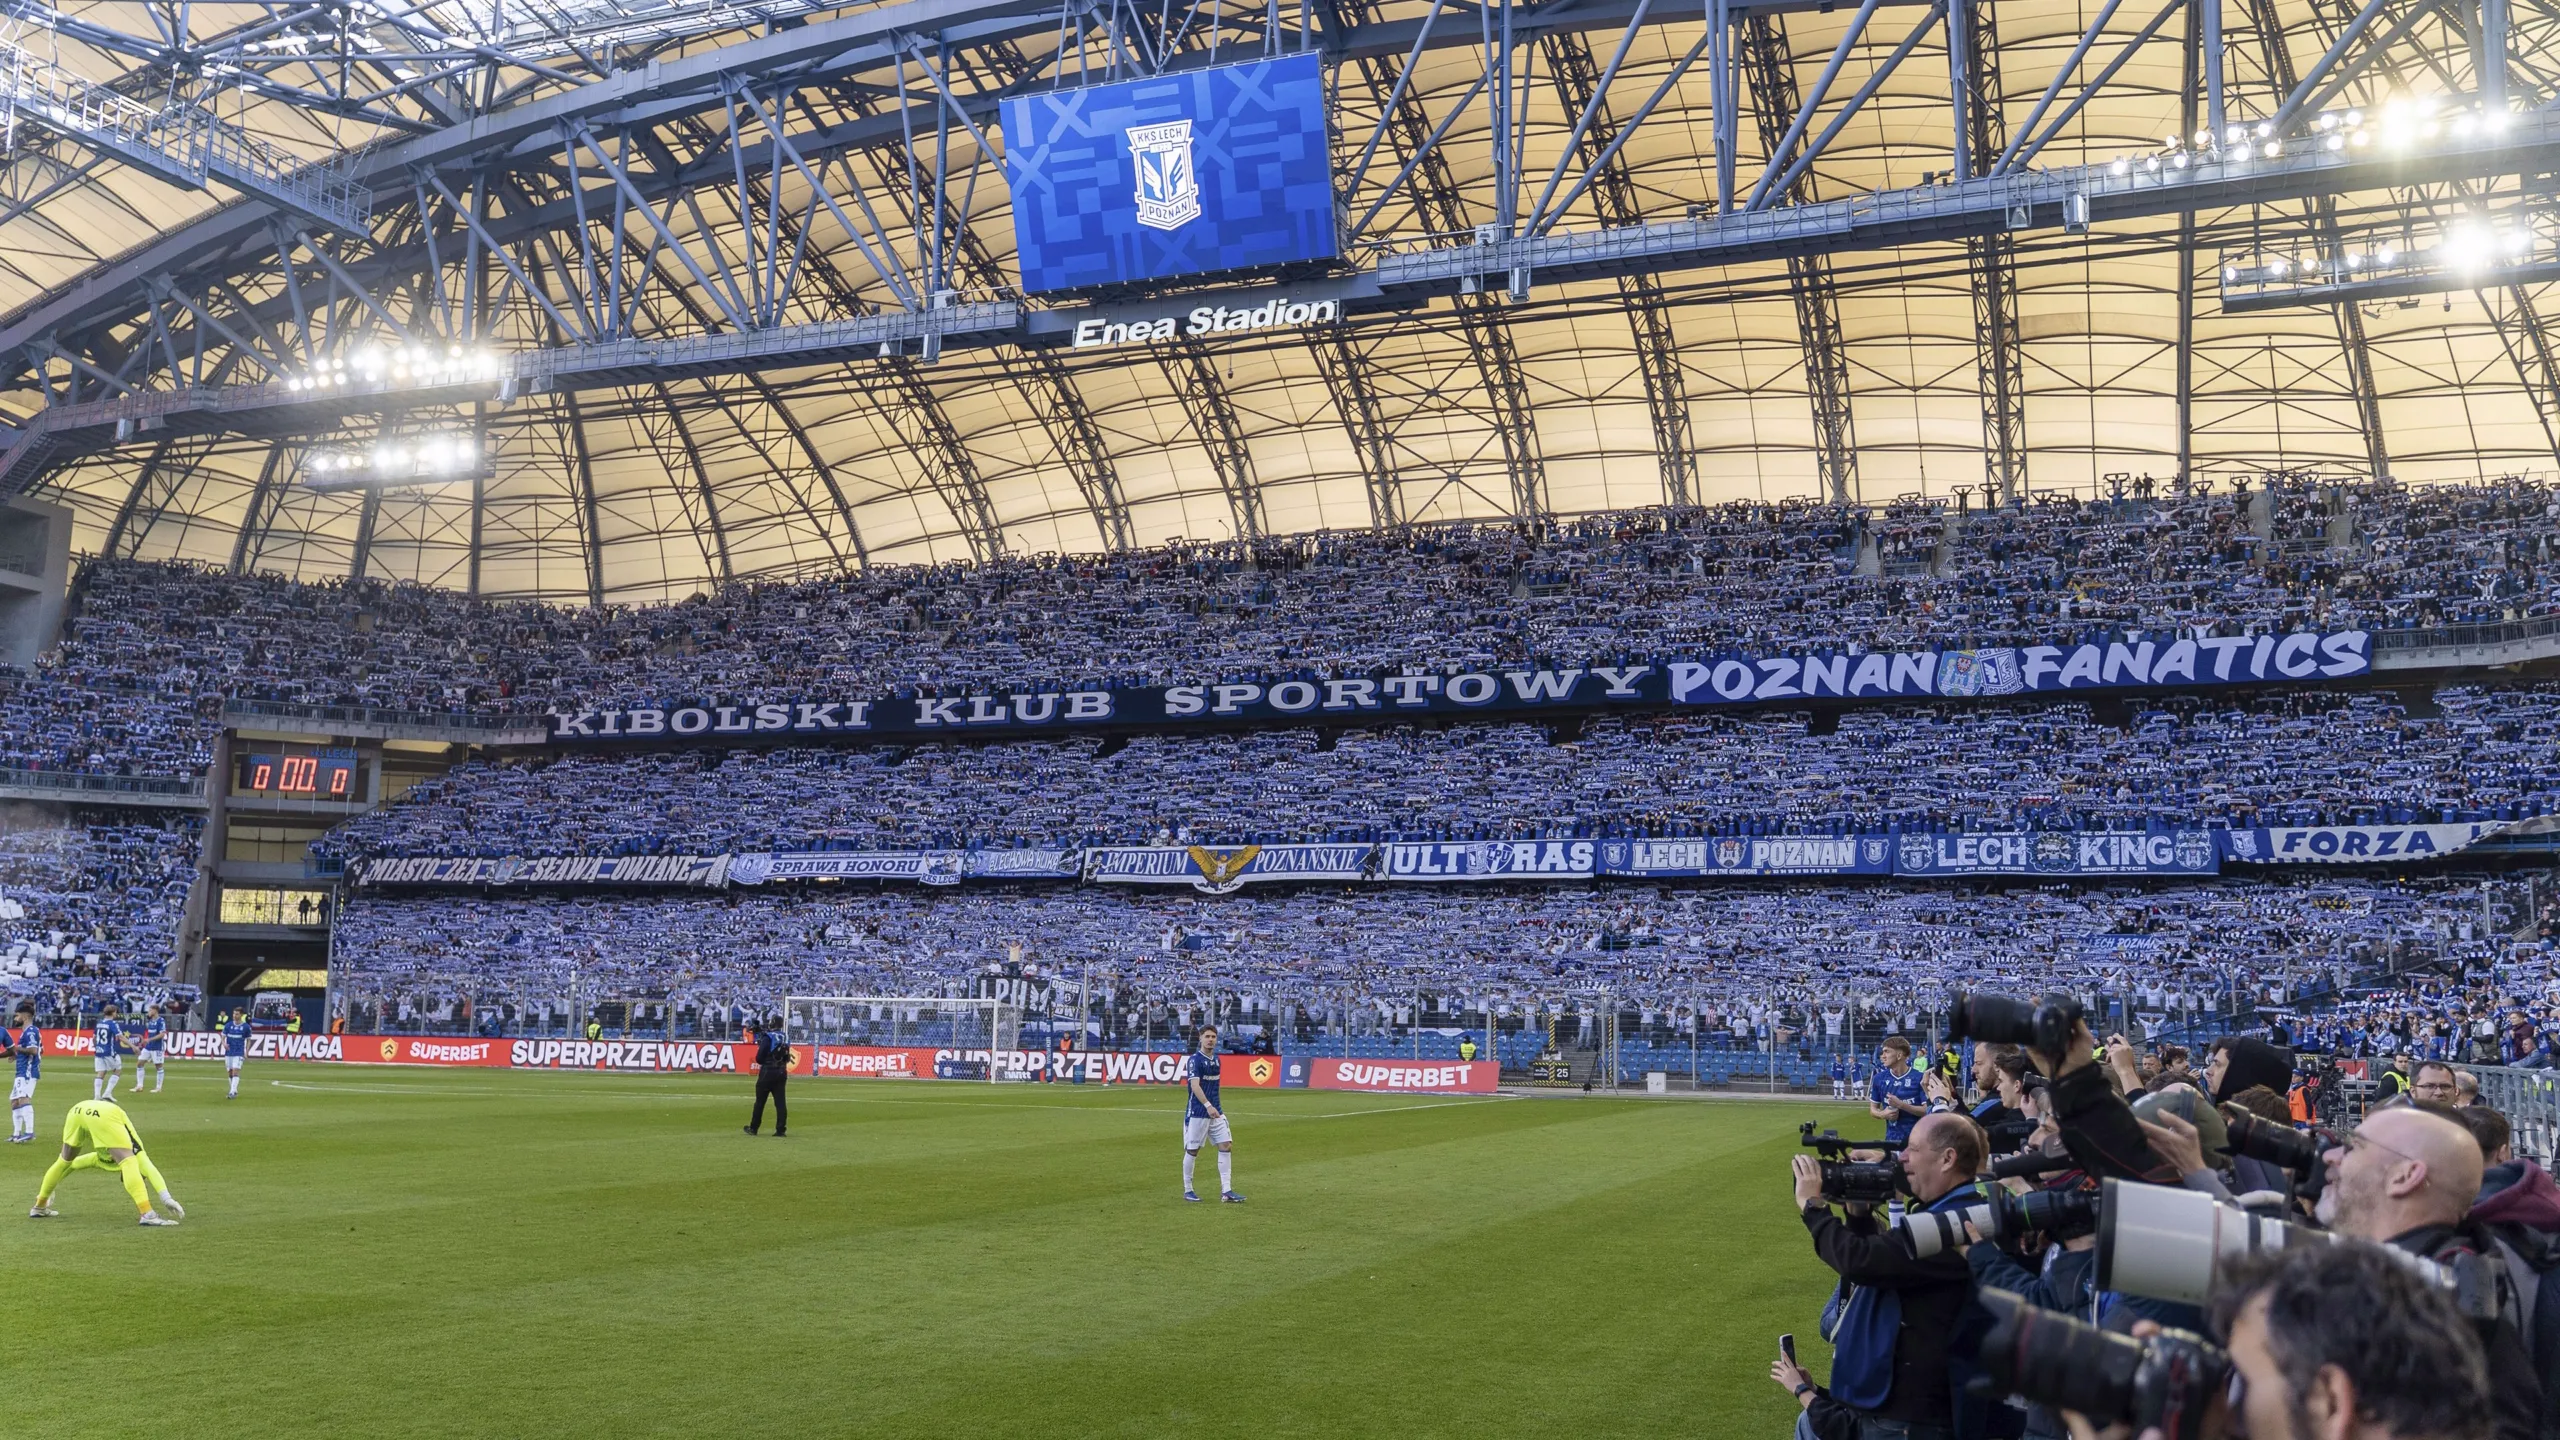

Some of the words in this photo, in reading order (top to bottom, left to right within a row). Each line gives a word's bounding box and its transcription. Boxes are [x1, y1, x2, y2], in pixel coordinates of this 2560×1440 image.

[1137, 131, 1157, 143] KKS
[1158, 127, 1183, 140] LECH
[1074, 317, 1176, 348] Enea
[1186, 298, 1336, 335] Stadion
[2021, 630, 2369, 690] FANATICS
[554, 701, 871, 736] KIBOLSKI
[914, 691, 1112, 725] KLUB
[1164, 665, 1651, 714] SPORTOWY
[326, 748, 358, 760] LECH
[253, 765, 272, 790] 0
[330, 768, 349, 794] 0
[1632, 842, 1707, 870] LECH
[1752, 835, 1856, 868] POZNAŃ
[1937, 837, 2027, 867] LECH
[2080, 835, 2174, 866] KING
[2281, 830, 2436, 857] FORZA
[369, 857, 440, 882] MIASTO
[611, 855, 698, 881] OWIANE
[771, 861, 841, 874] SPRAWA
[843, 860, 921, 873] HONORU
[1104, 851, 1189, 874] IMPERIUM
[1252, 847, 1358, 872] POZNAŃSKIE
[921, 873, 937, 884] KKS
[938, 874, 961, 884] LECH
[55, 1034, 96, 1052] SUPE
[163, 1031, 343, 1059] UPERZEWAGA
[409, 1041, 490, 1061] SUPERBET
[511, 1040, 736, 1069] SUPERPRZEWAGA
[818, 1051, 909, 1072] SUPERBET
[1336, 1062, 1472, 1087] SUPERBET
[1556, 1068, 1569, 1078] 25
